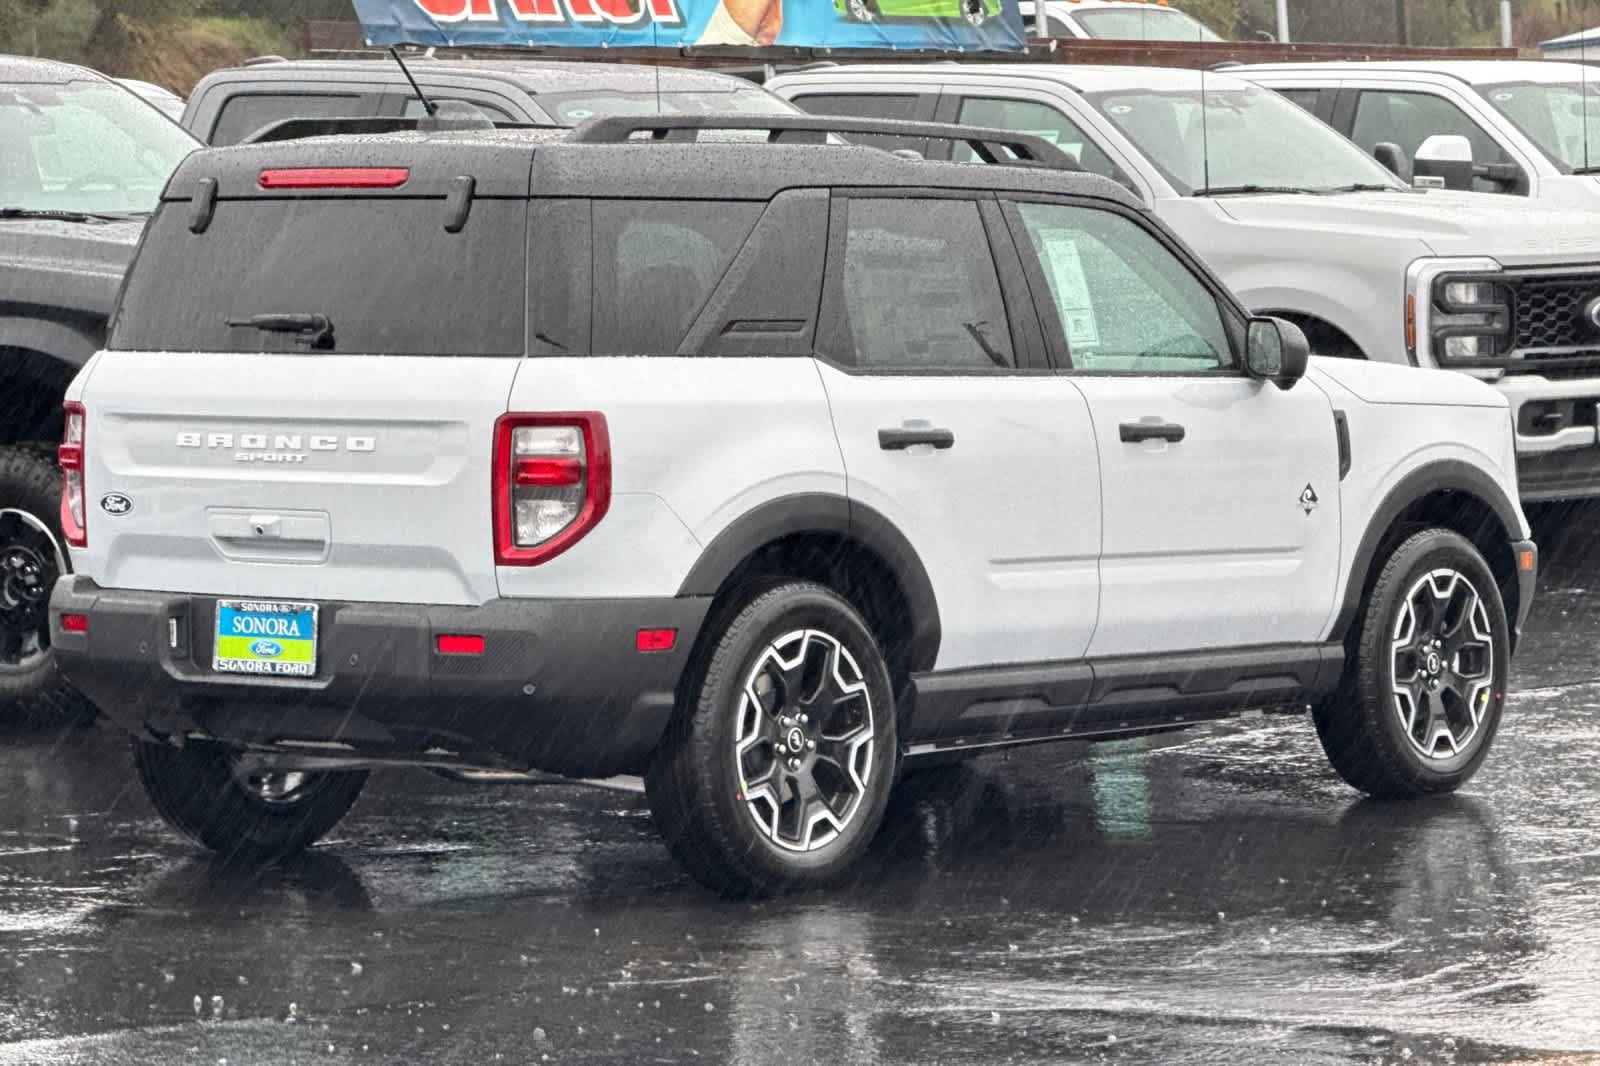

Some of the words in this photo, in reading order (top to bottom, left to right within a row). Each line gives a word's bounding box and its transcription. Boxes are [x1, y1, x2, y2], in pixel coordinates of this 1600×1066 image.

[176, 432, 375, 451] BRONCO
[235, 452, 307, 463] SPORT
[103, 495, 128, 512] Ford
[241, 602, 278, 612] SONORA
[232, 616, 300, 637] SONORA
[254, 640, 279, 656] Ford
[219, 660, 272, 673] SONORA
[276, 663, 307, 674] FORD
